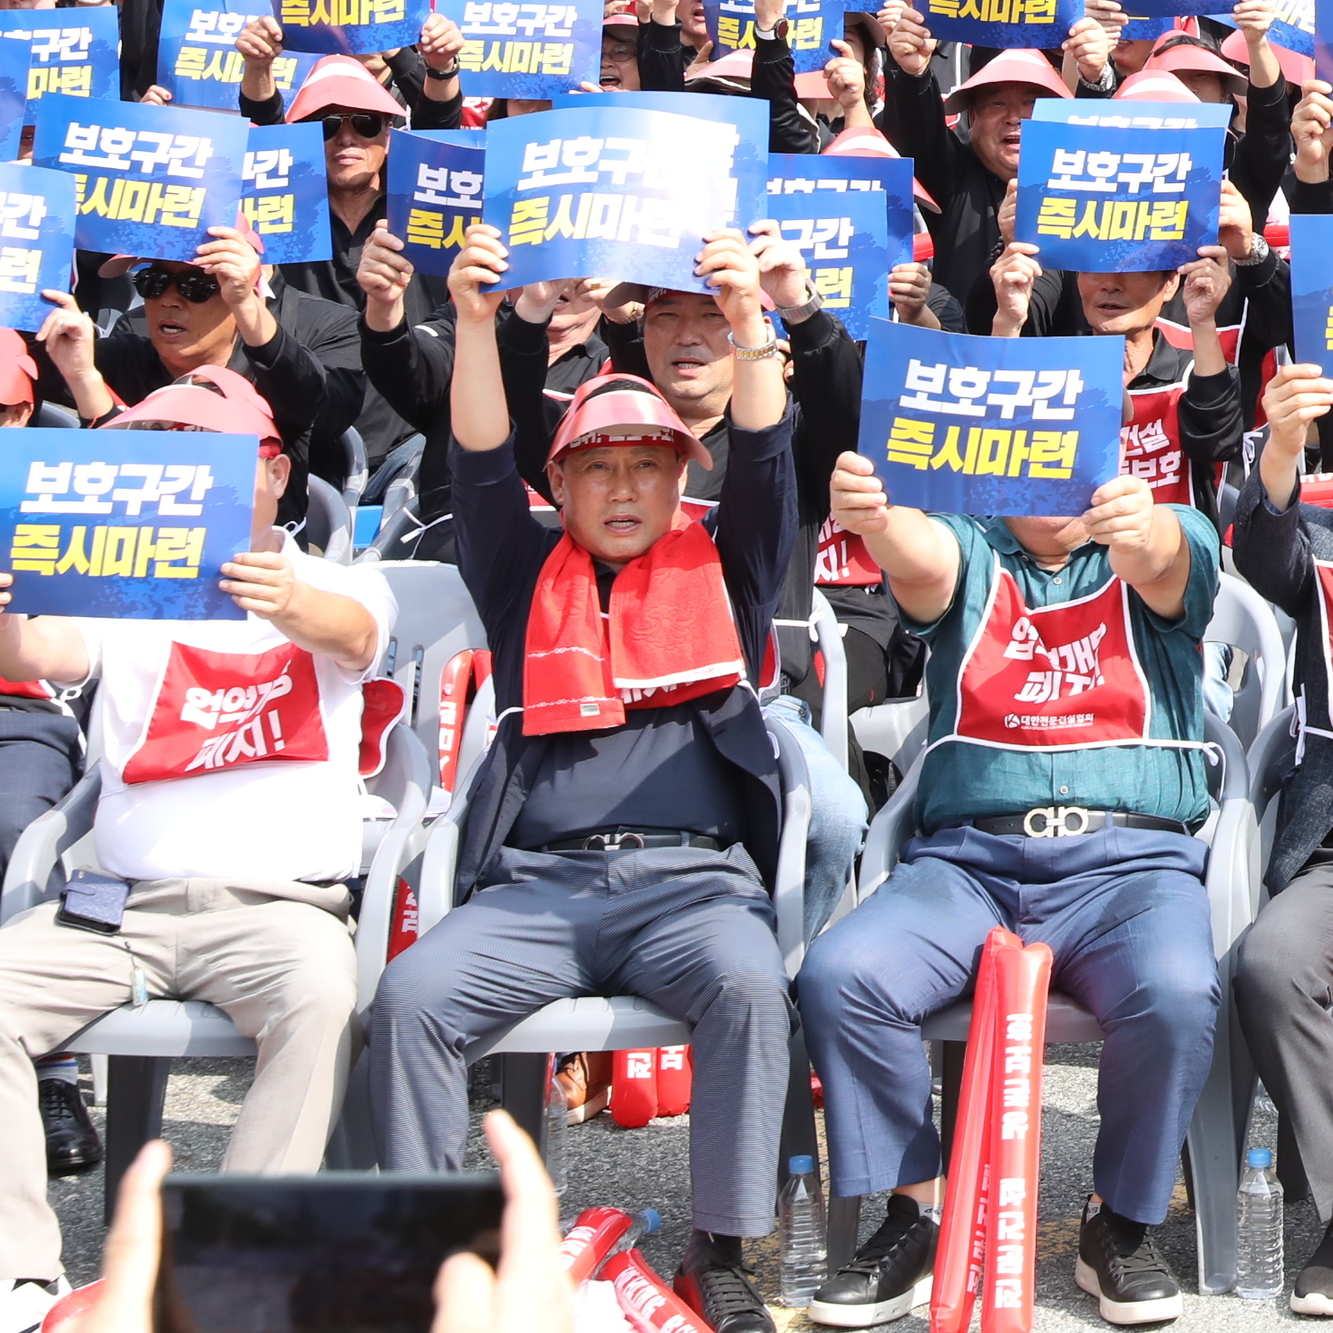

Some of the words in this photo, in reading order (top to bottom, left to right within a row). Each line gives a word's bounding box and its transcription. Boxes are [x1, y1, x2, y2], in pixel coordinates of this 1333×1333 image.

[462, 1, 577, 37] 보호구간
[457, 38, 574, 76] 즉시마련
[1049, 150, 1191, 193] 보호구간
[1039, 198, 1187, 239] 즉시마련
[899, 359, 1084, 420] 보호구간
[887, 418, 1080, 480] 즉시마련
[22, 462, 212, 515] 보호구간
[9, 525, 202, 581] 즉시마련
[1021, 712, 1094, 728] 대한전문건설협회
[1001, 1014, 1033, 1140] 생존보호
[994, 1178, 1027, 1308] 전문건설
